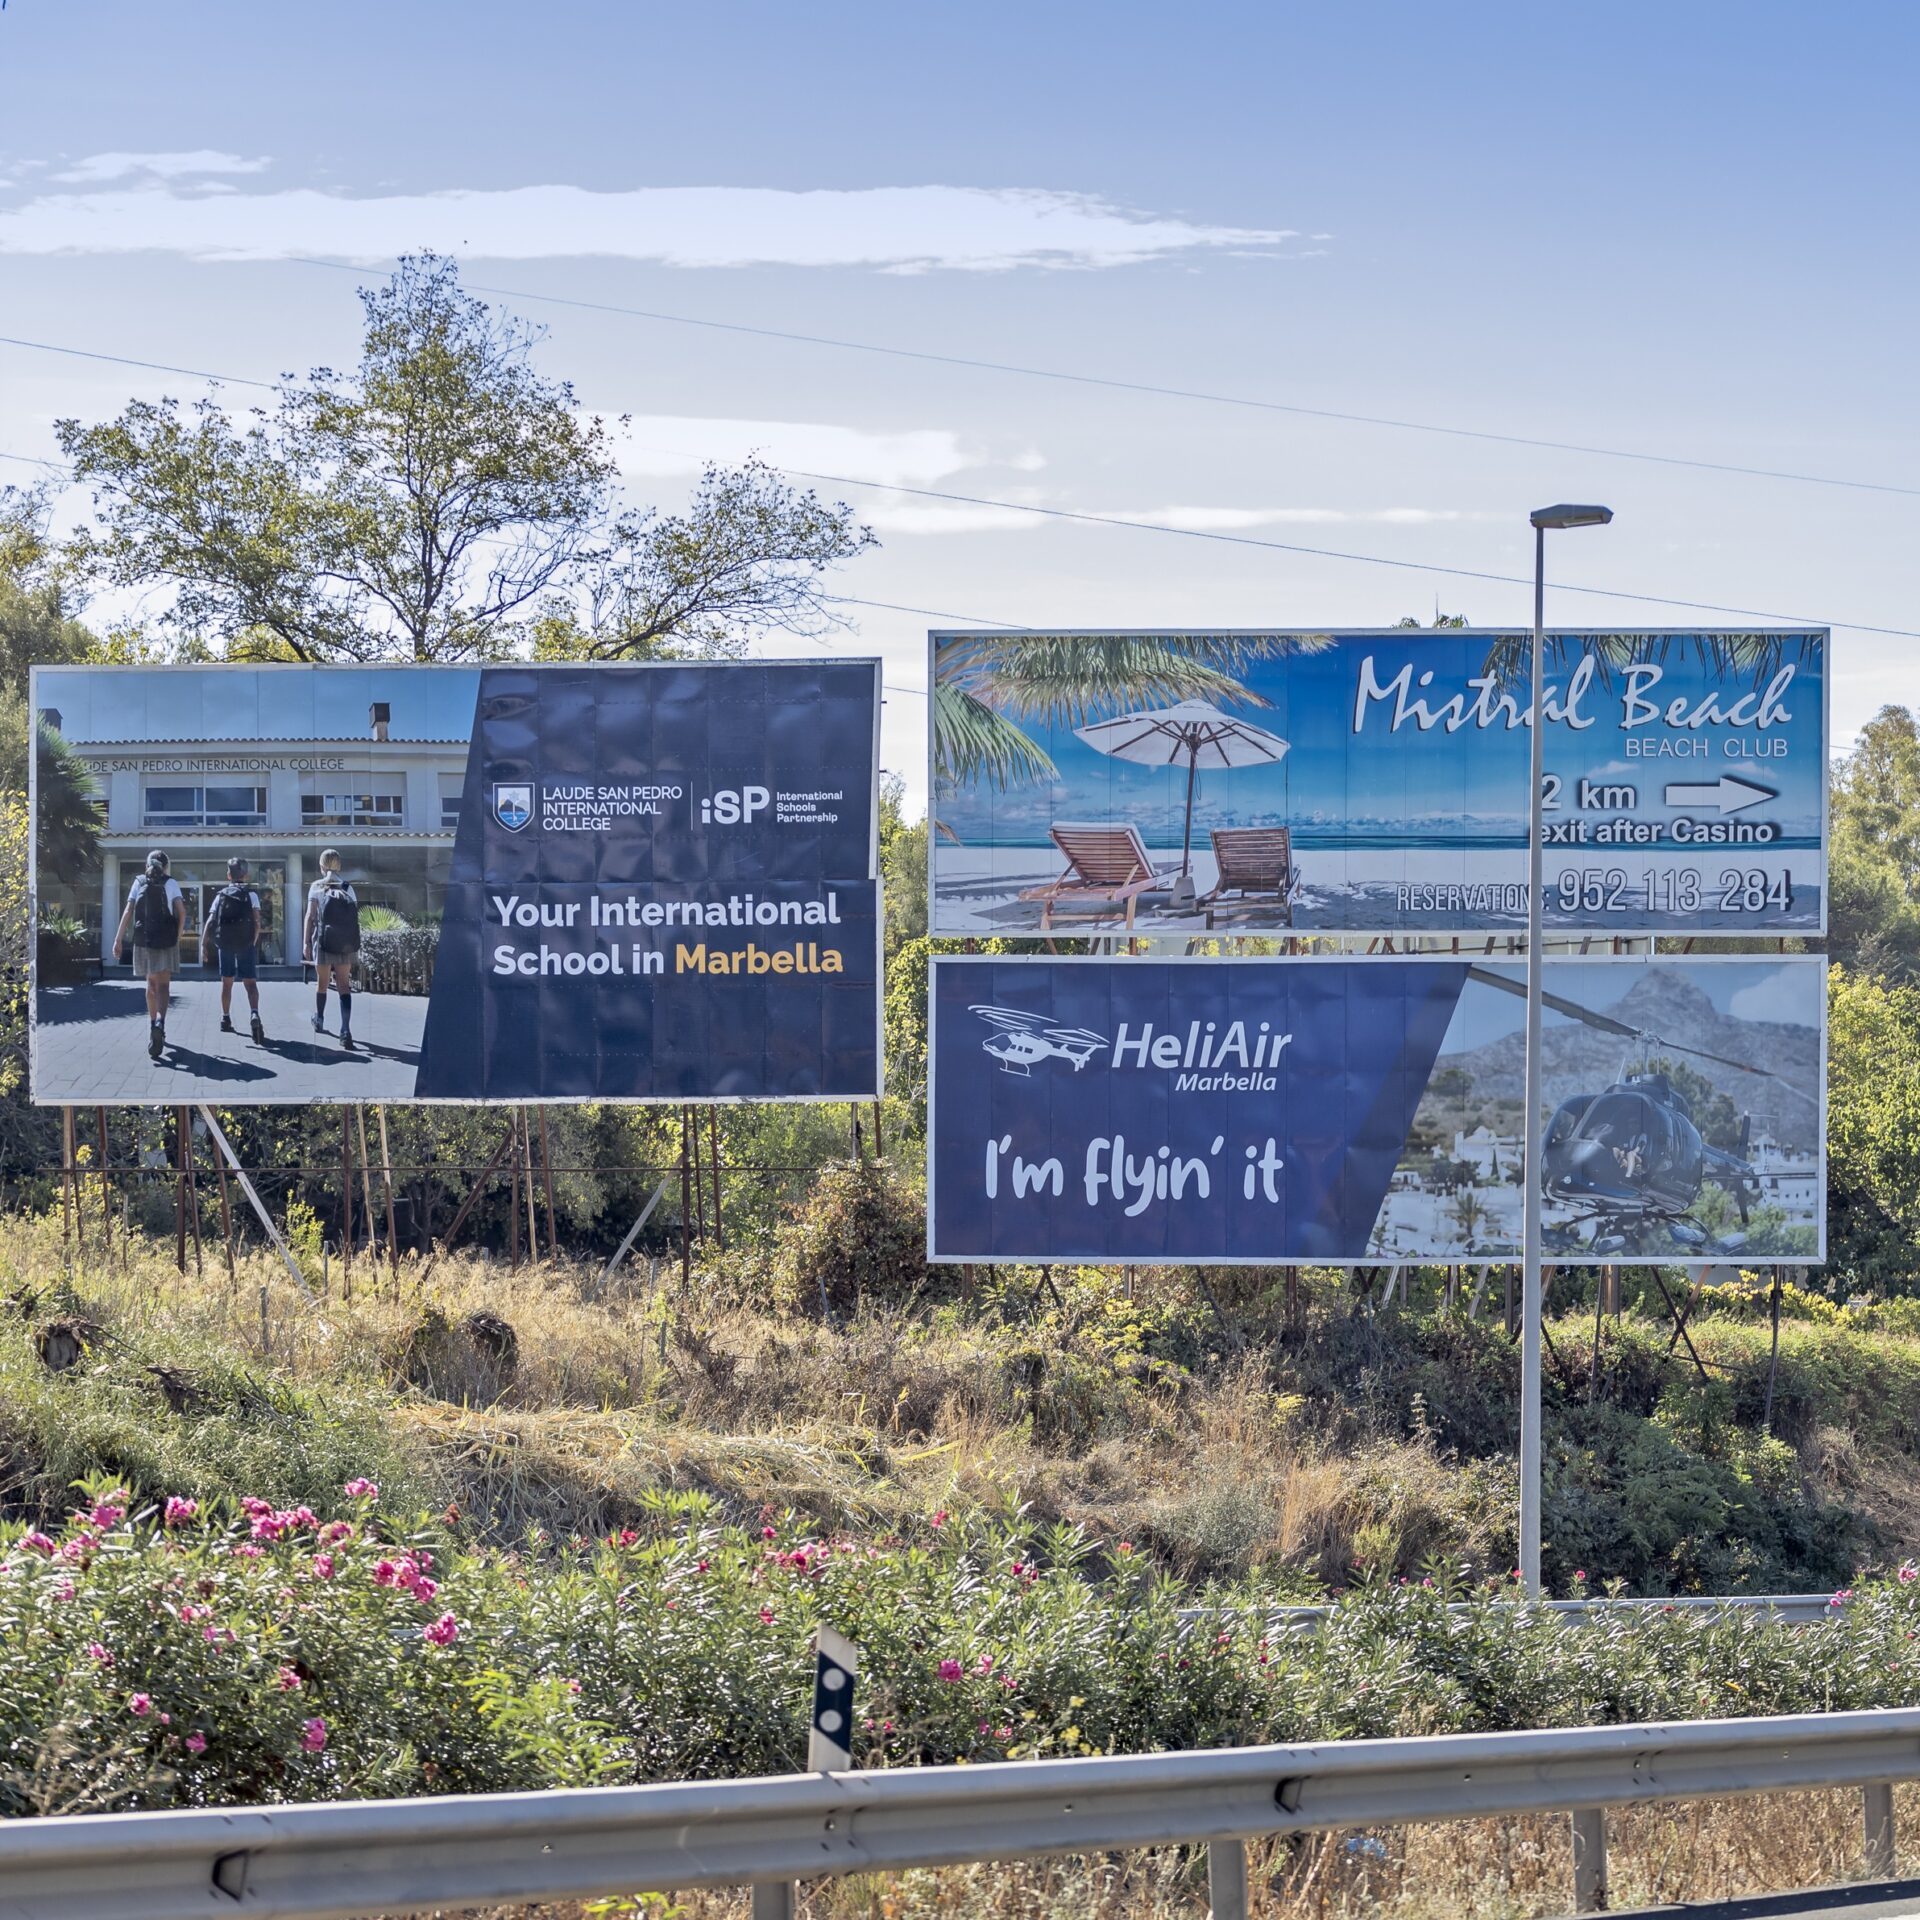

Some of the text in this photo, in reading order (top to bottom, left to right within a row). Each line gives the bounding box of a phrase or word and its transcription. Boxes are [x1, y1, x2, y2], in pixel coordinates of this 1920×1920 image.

[1619, 662, 1797, 731] Beach
[1625, 738, 1788, 758] BEACH CLUB
[112, 760, 138, 772] SAN
[142, 760, 182, 771] PEDRO
[186, 759, 286, 771] INTERNATIONAL
[289, 758, 344, 770] COLLEGE
[542, 785, 683, 800] LAUDE SAN PEDRO
[776, 790, 843, 801] International
[1542, 774, 1635, 809] 2 km
[542, 801, 662, 816] INTERNATIONAL
[701, 785, 771, 825] iSP
[776, 802, 817, 813] Schools
[542, 817, 612, 831] COLLEGE
[776, 813, 838, 824] Partnership
[1596, 818, 1663, 843] after
[1671, 819, 1773, 843] Casino
[1397, 868, 1790, 912] RESERVATION: 952 113 284
[492, 892, 841, 927] Your International
[493, 942, 844, 976] School in Marbella
[1111, 1020, 1293, 1069] HeliAir
[1175, 1072, 1277, 1091] Marbella
[985, 1134, 1284, 1217] I'm flyin' it
